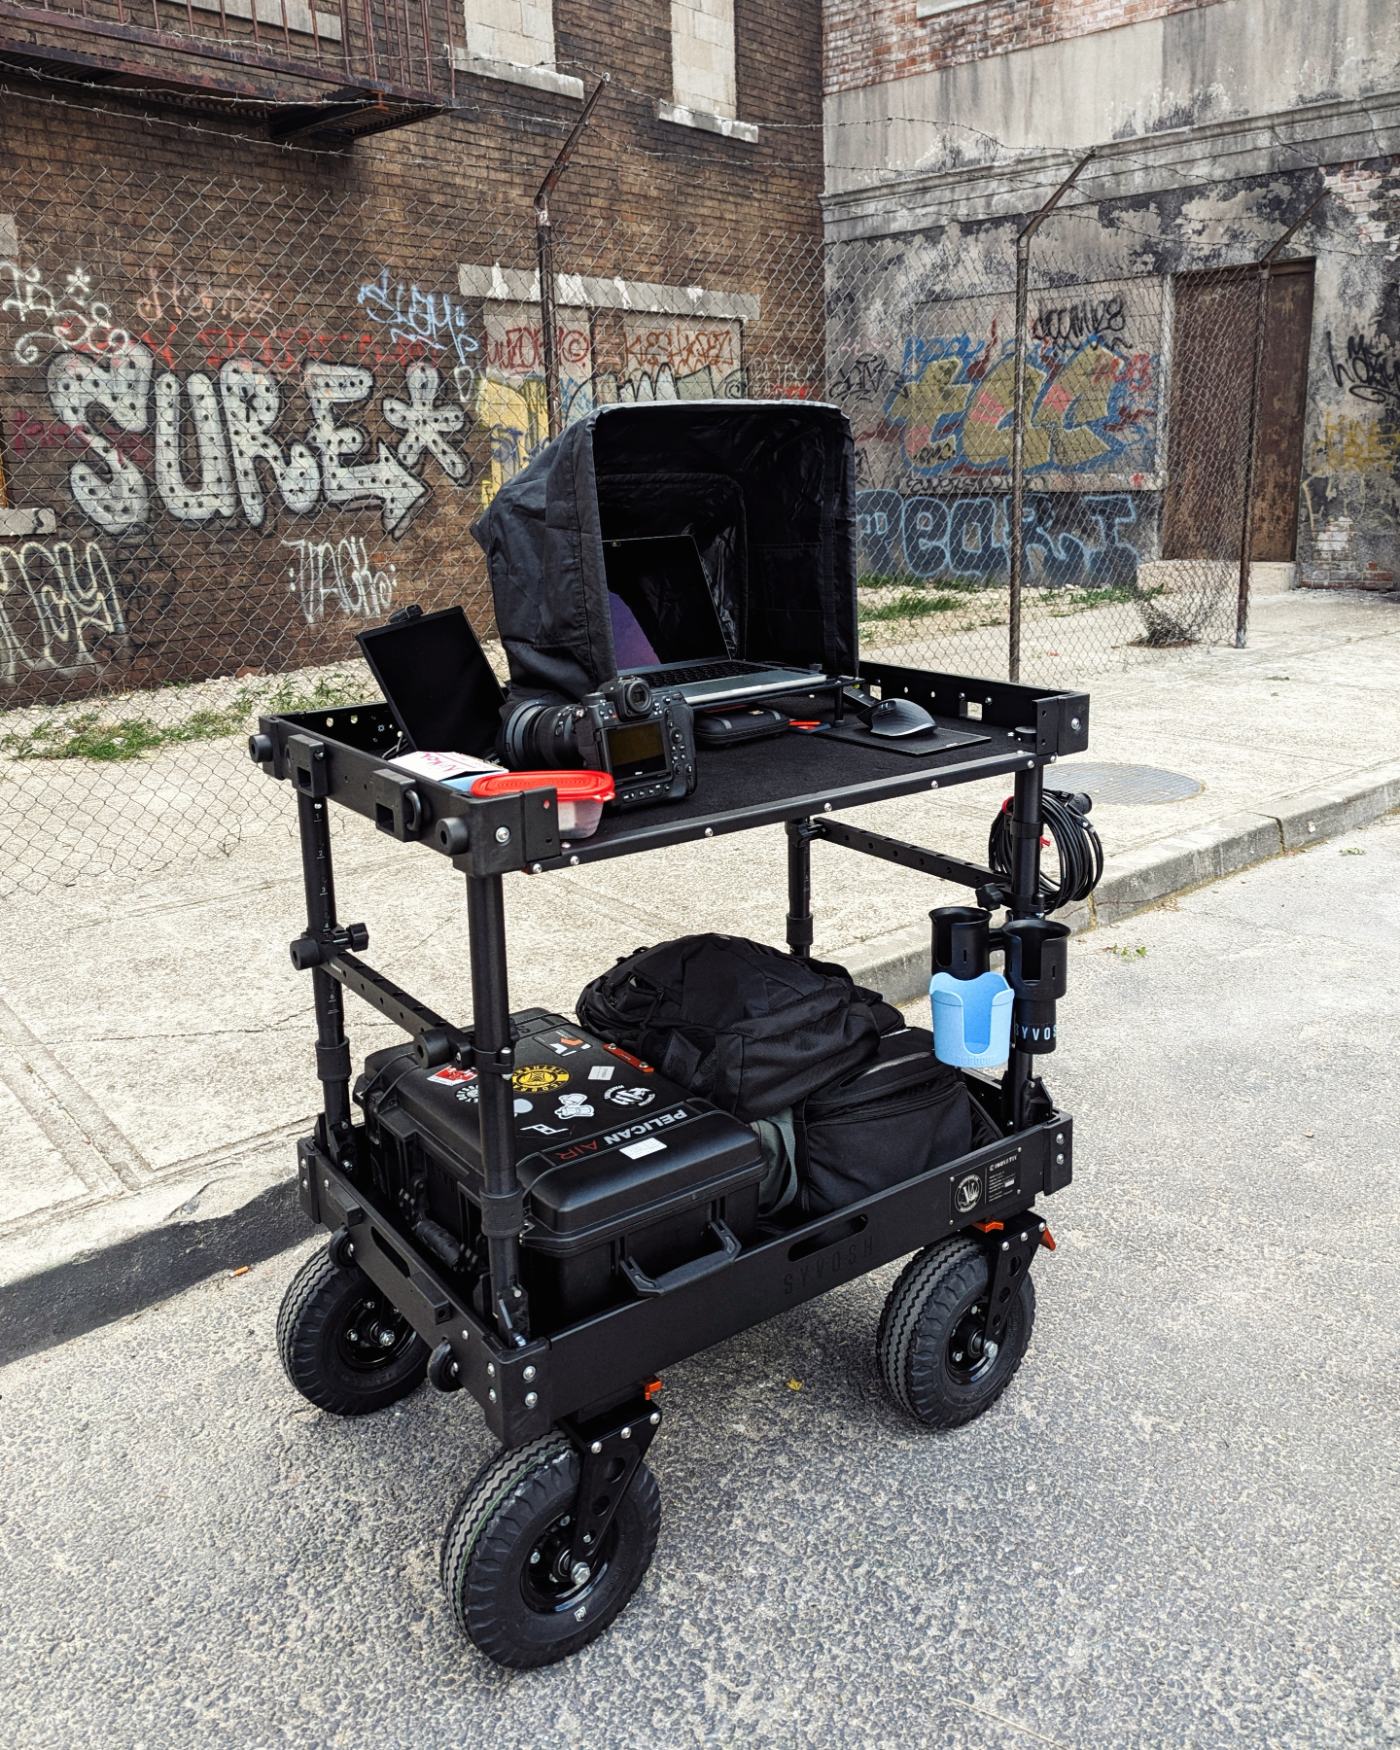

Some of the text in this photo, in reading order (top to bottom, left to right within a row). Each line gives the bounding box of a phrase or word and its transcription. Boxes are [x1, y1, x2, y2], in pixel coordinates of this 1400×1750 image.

[556, 1109, 688, 1160] PELICAN AIR
[783, 1235, 873, 1295] SYVOSH
